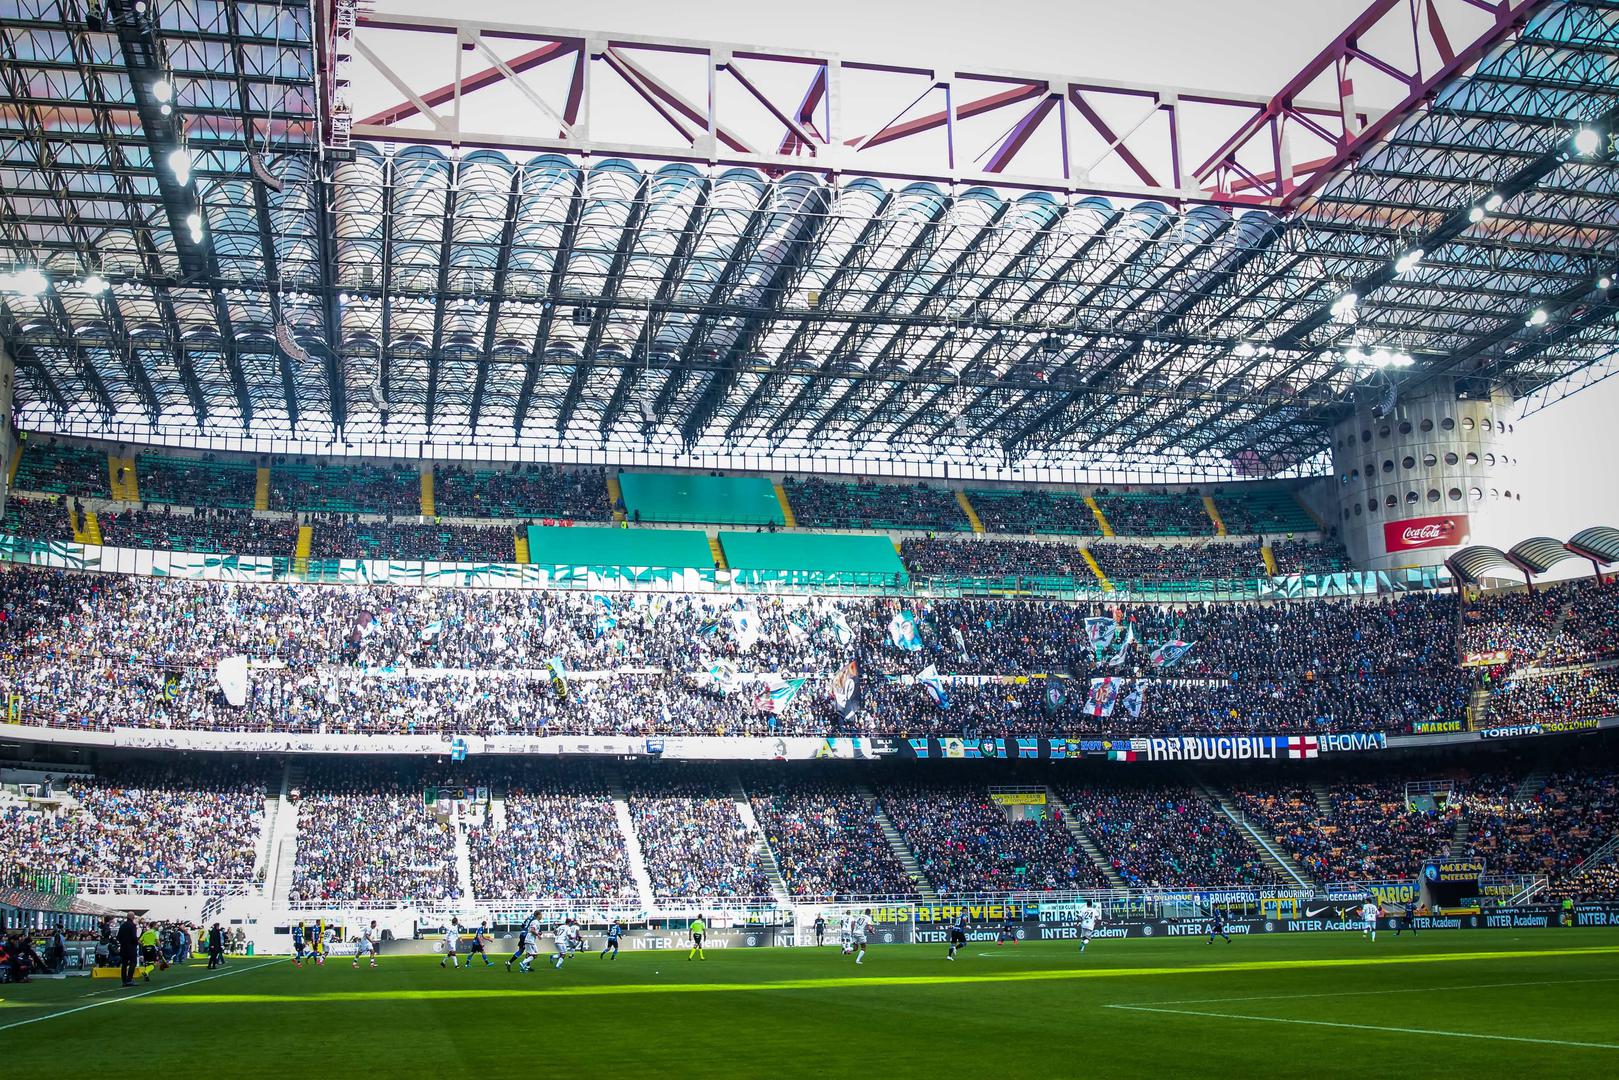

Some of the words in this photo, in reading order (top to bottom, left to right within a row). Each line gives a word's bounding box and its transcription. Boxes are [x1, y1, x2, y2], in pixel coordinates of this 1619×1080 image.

[1402, 524, 1441, 540] Coca-Cola
[1421, 720, 1460, 733] MARCHE
[1483, 726, 1539, 738] TORRITA
[1328, 734, 1379, 751] ROMA
[1278, 889, 1315, 898] MOURINHO
[1371, 885, 1414, 903] PARIGI
[1084, 911, 1094, 919] 24
[1486, 914, 1512, 927] INTER
[1514, 914, 1549, 927] Academy
[1578, 912, 1606, 925] INTER
[1168, 924, 1200, 935] INTER
[1205, 922, 1250, 934] Ademy
[1288, 920, 1322, 931] INTER
[1432, 917, 1461, 929] Academy
[909, 931, 947, 942] INTER
[1041, 928, 1078, 939] INTER
[632, 937, 672, 949] INTER
[676, 937, 729, 949] Acaemy
